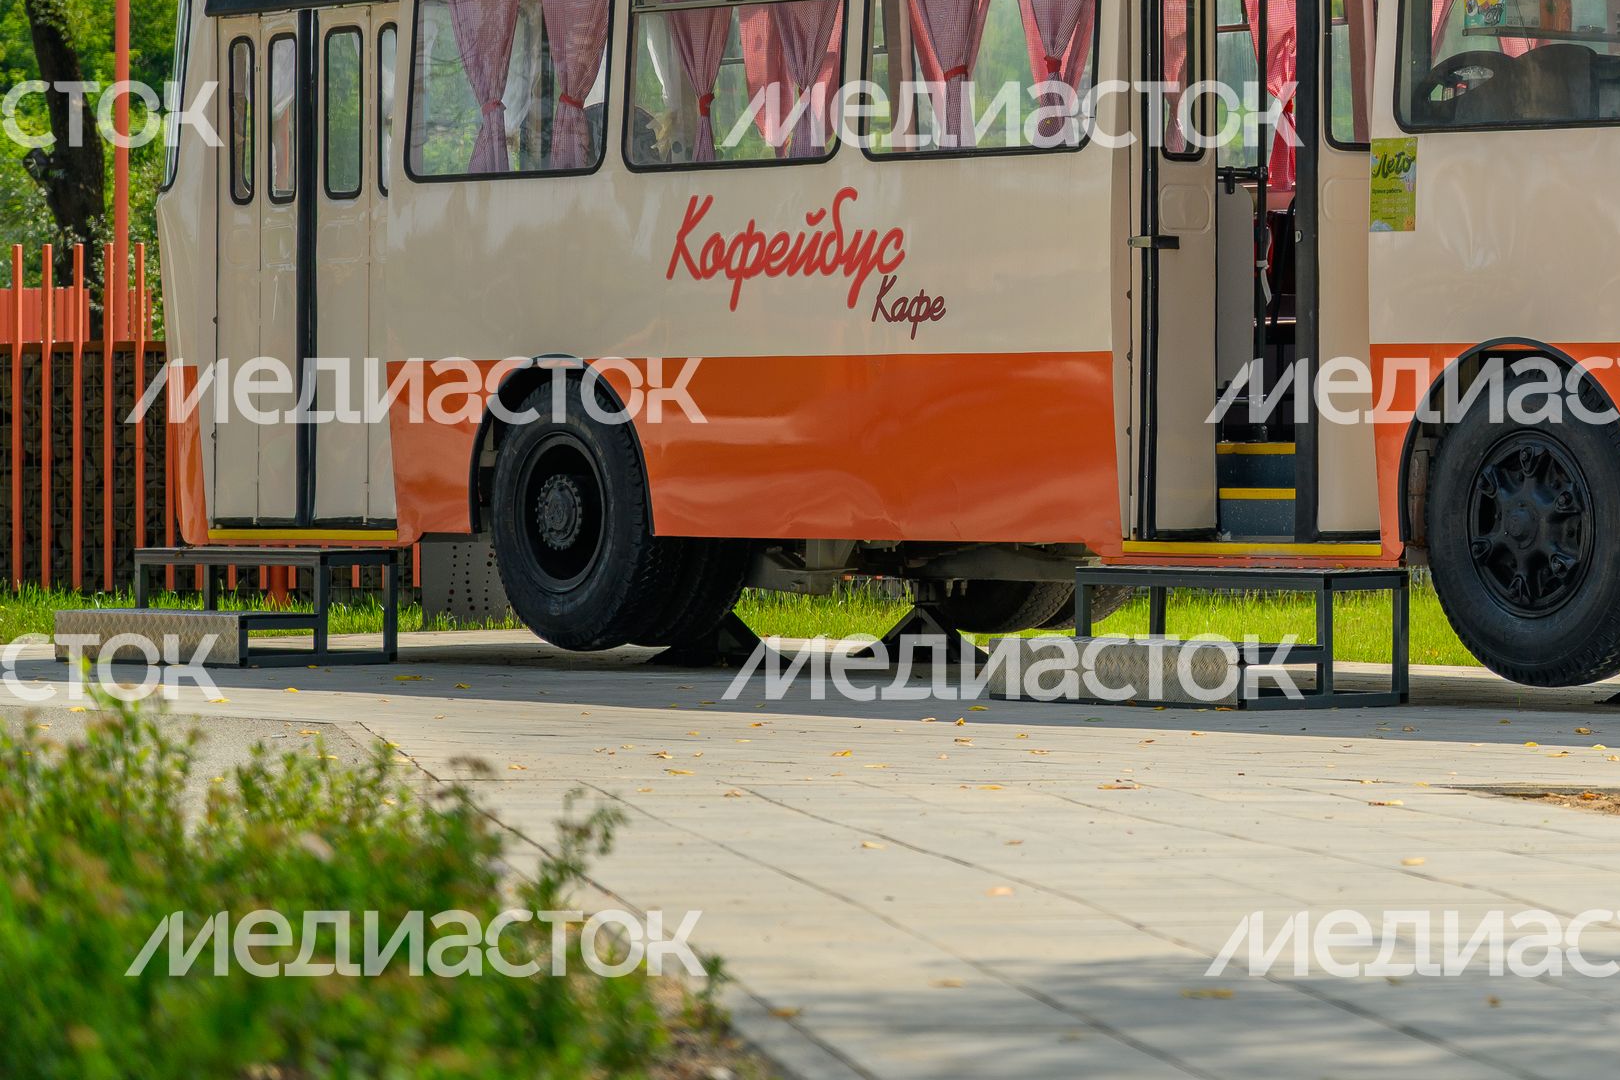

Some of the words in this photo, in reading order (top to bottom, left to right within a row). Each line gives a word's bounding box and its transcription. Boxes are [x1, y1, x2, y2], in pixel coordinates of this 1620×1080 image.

[1371, 151, 1416, 179] Лето
[665, 186, 906, 312] Кофейбус
[871, 274, 947, 340] Кафе
